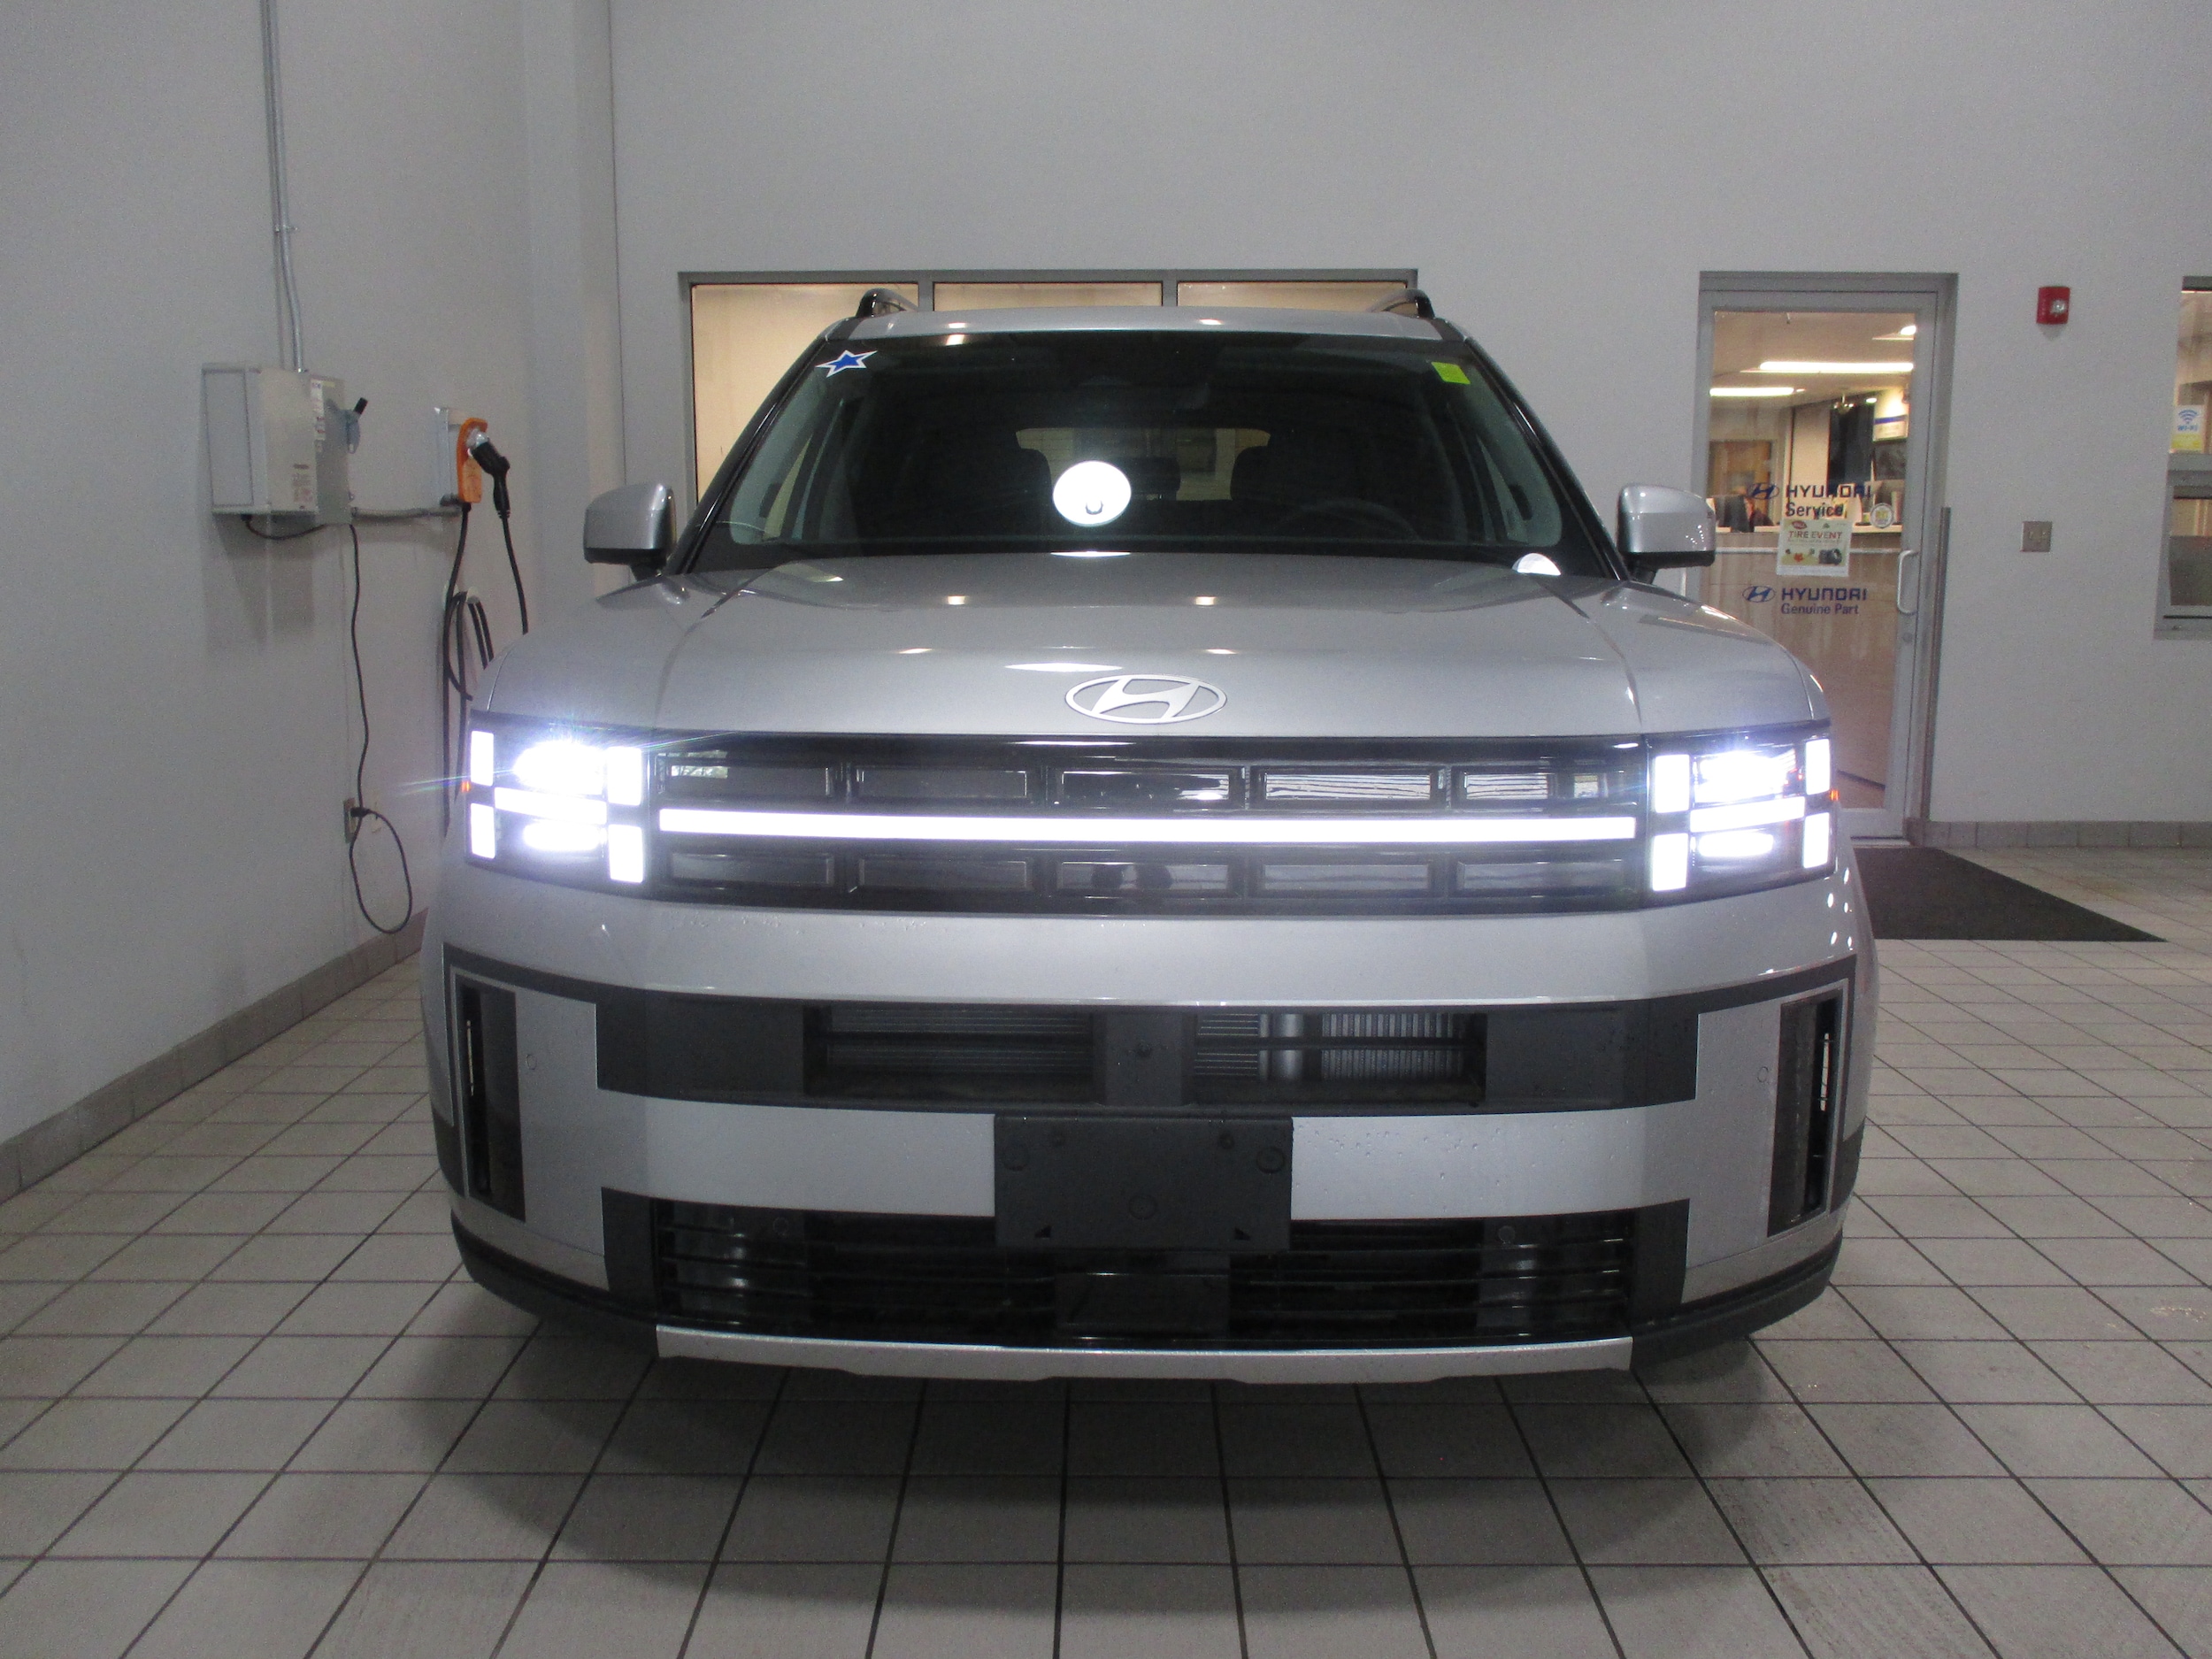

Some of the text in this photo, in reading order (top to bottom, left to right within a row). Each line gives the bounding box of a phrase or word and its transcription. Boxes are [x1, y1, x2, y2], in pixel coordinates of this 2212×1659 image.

[1786, 485, 1870, 498] HYUDAI
[1786, 502, 1844, 518] Service
[1781, 588, 1868, 601] HYUNDAI
[1781, 603, 1859, 614] Genuine Part
